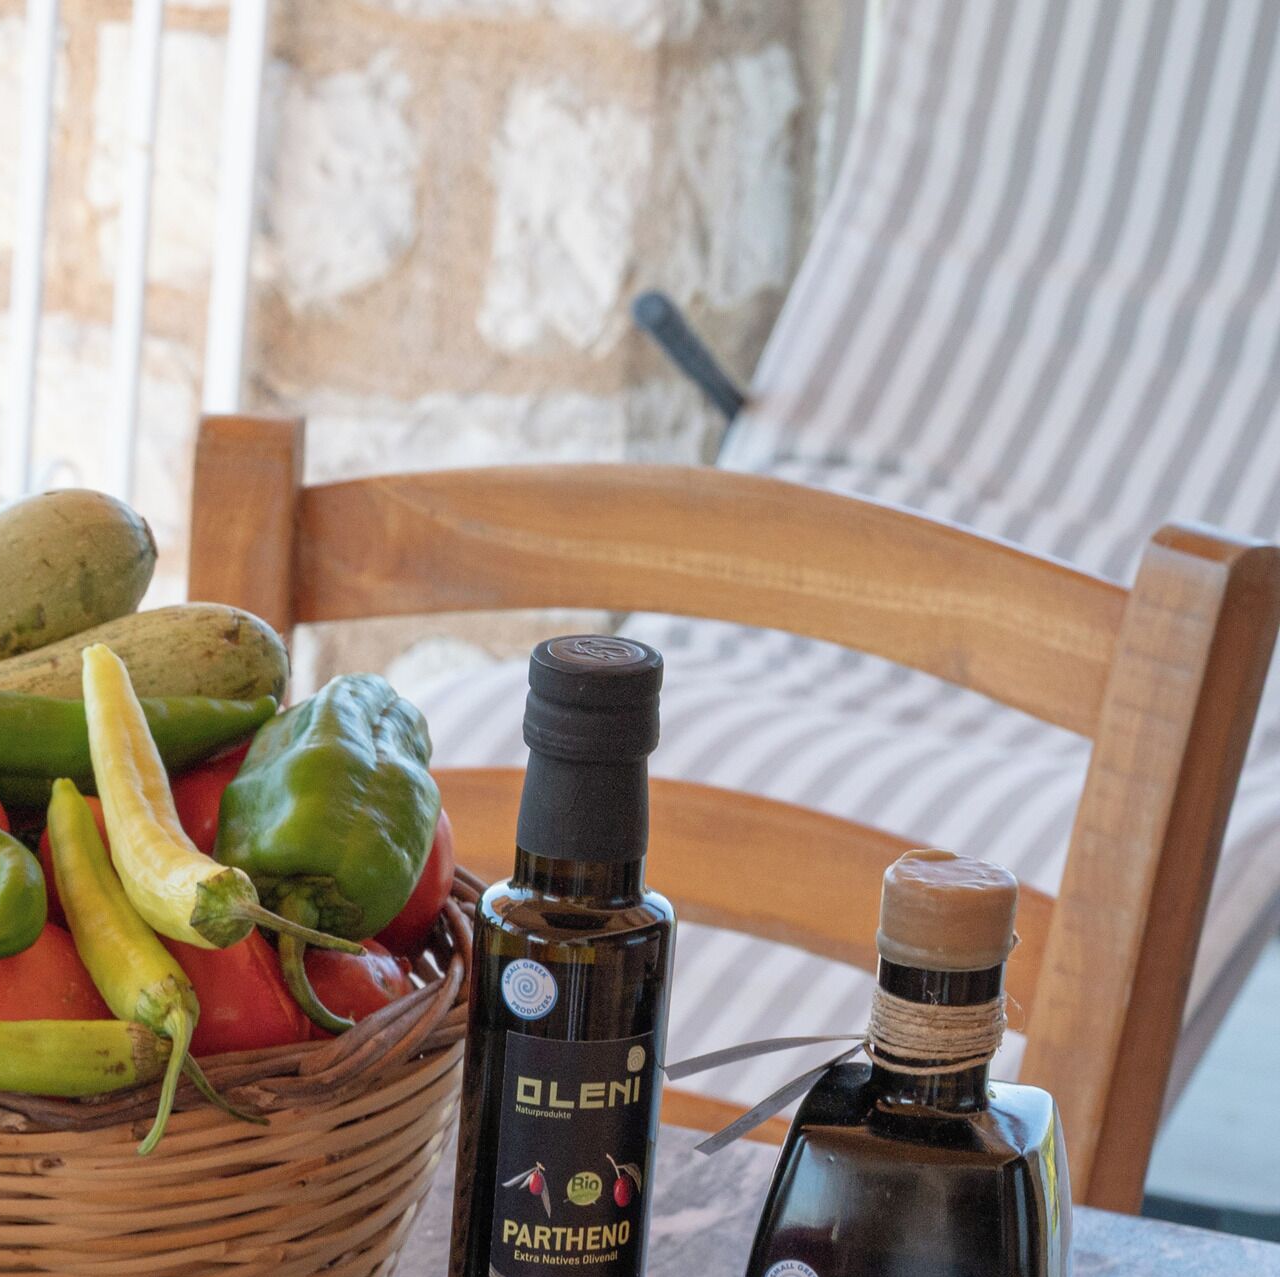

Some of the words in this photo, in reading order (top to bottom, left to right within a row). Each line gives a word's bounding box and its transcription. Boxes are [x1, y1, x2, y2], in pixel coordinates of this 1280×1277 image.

[505, 963, 520, 984] SMALL
[523, 962, 549, 977] GREEK
[511, 995, 552, 1014] PRODUCERS
[515, 1104, 572, 1119] Naturprodukte
[572, 1175, 599, 1192] Bio
[502, 1219, 630, 1252] PARTHENO
[514, 1250, 540, 1263] Extra
[542, 1254, 580, 1265] Natives
